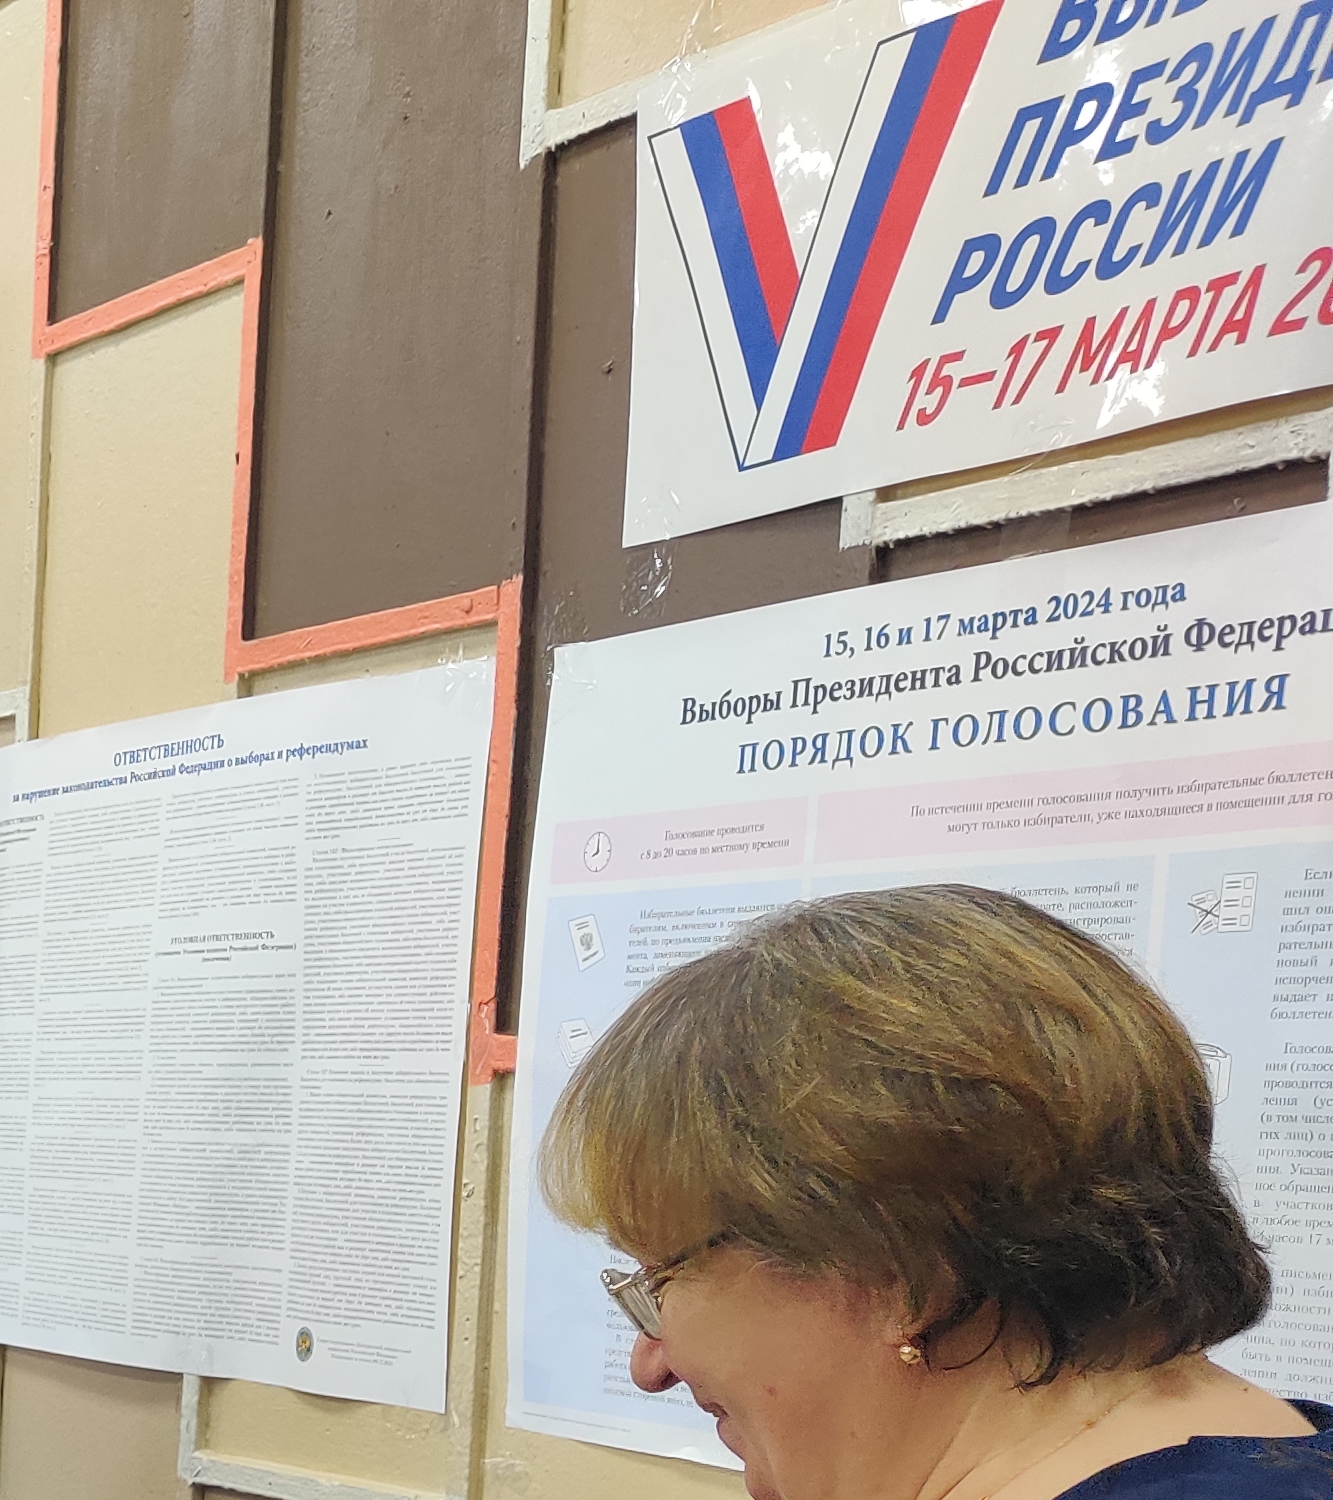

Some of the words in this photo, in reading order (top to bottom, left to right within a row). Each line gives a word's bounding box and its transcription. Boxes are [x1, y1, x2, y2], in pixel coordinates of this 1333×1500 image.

[982, 0, 1333, 198] ПРЕЗИД
[930, 136, 1285, 326] РОССИИ
[1055, 264, 1267, 395] МАРТА
[823, 630, 855, 658] 15,
[864, 623, 890, 651] 16
[896, 626, 912, 646] и
[922, 613, 951, 642] 17
[956, 606, 1038, 640] марта
[1046, 587, 1113, 623] 2024
[1120, 582, 1187, 613] года
[679, 689, 783, 726] Выборы
[790, 663, 962, 715] Президента
[970, 624, 1173, 683] Российской
[736, 721, 914, 774] ПОРЯДОК
[928, 673, 1292, 751] ГОЛОСОВАНИЯ
[113, 734, 225, 767] ОТВЕТСТВЕННОСТЬ
[21, 788, 60, 804] нарушение
[62, 776, 128, 795] законодательства
[130, 764, 176, 784] Российской
[179, 757, 225, 778] Федерации
[227, 757, 232, 767] о
[235, 750, 275, 770] выборах
[277, 749, 283, 760] и
[286, 738, 368, 762] референдумах
[911, 805, 926, 818] По
[927, 801, 983, 816] истечении
[985, 797, 1034, 814] времени
[1036, 790, 1112, 807] голосования
[1115, 786, 1174, 802] получить
[1176, 776, 1265, 796] избирательные
[947, 821, 978, 835] могут
[981, 818, 1020, 831] только
[1023, 812, 1094, 829] избиратели,
[1096, 810, 1121, 825] уже
[1124, 803, 1204, 821] находящиеся
[1206, 801, 1213, 812] в
[1215, 795, 1285, 812] помещении
[1288, 792, 1313, 806] для
[664, 828, 716, 841] Голосование
[717, 823, 765, 838] проводится
[645, 849, 651, 860] 8
[652, 851, 662, 860] до
[663, 847, 674, 859] 20
[675, 847, 698, 857] часов
[699, 846, 710, 856] по
[710, 843, 751, 854] местному
[751, 838, 790, 852] времени
[1074, 882, 1120, 896] который
[1126, 883, 1139, 893] не
[1068, 899, 1137, 913] расположен-
[1276, 956, 1318, 968] новый
[1272, 993, 1318, 1003] выдает
[1270, 1007, 1333, 1020] бюллетен
[1265, 1062, 1287, 1072] ния
[1261, 1096, 1299, 1106] ления
[1260, 1111, 1273, 1125] (в
[1276, 1114, 1298, 1123] том
[1259, 1131, 1280, 1140] гих
[1283, 1129, 1314, 1143] лиц)
[1255, 1182, 1276, 1191] ное
[1264, 1214, 1301, 1226] любое
[1309, 1233, 1323, 1245] 17
[1241, 1348, 1271, 1362] быть
